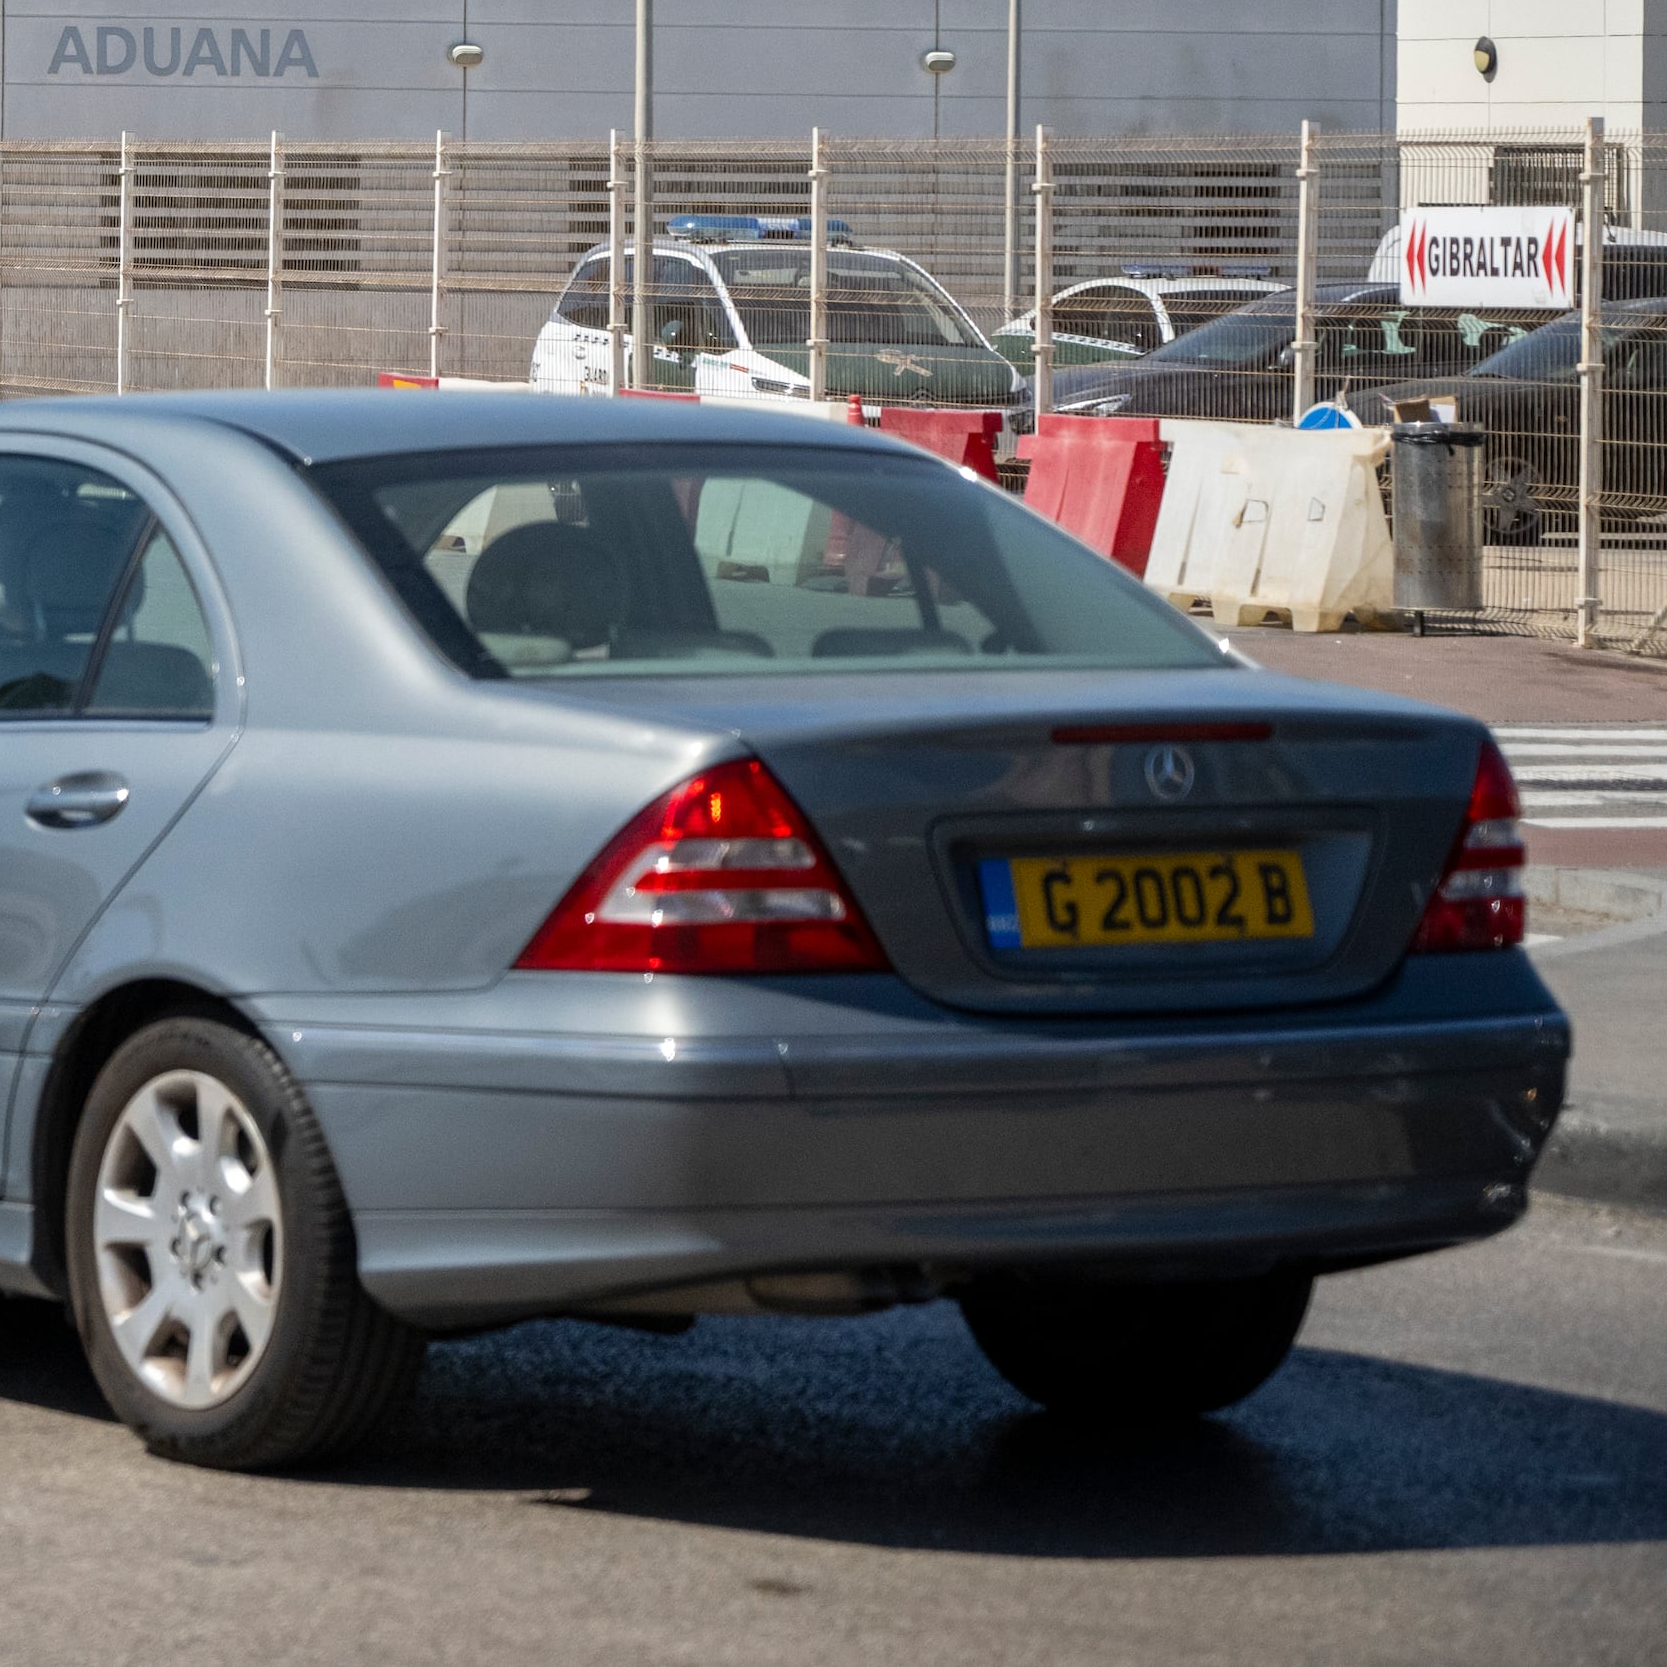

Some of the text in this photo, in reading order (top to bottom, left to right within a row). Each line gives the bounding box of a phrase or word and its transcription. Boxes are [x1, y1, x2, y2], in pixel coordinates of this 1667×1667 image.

[47, 25, 320, 78] ADUANA
[1428, 236, 1540, 278] GIBRALTAR
[1042, 861, 1293, 934] G 2002 B
